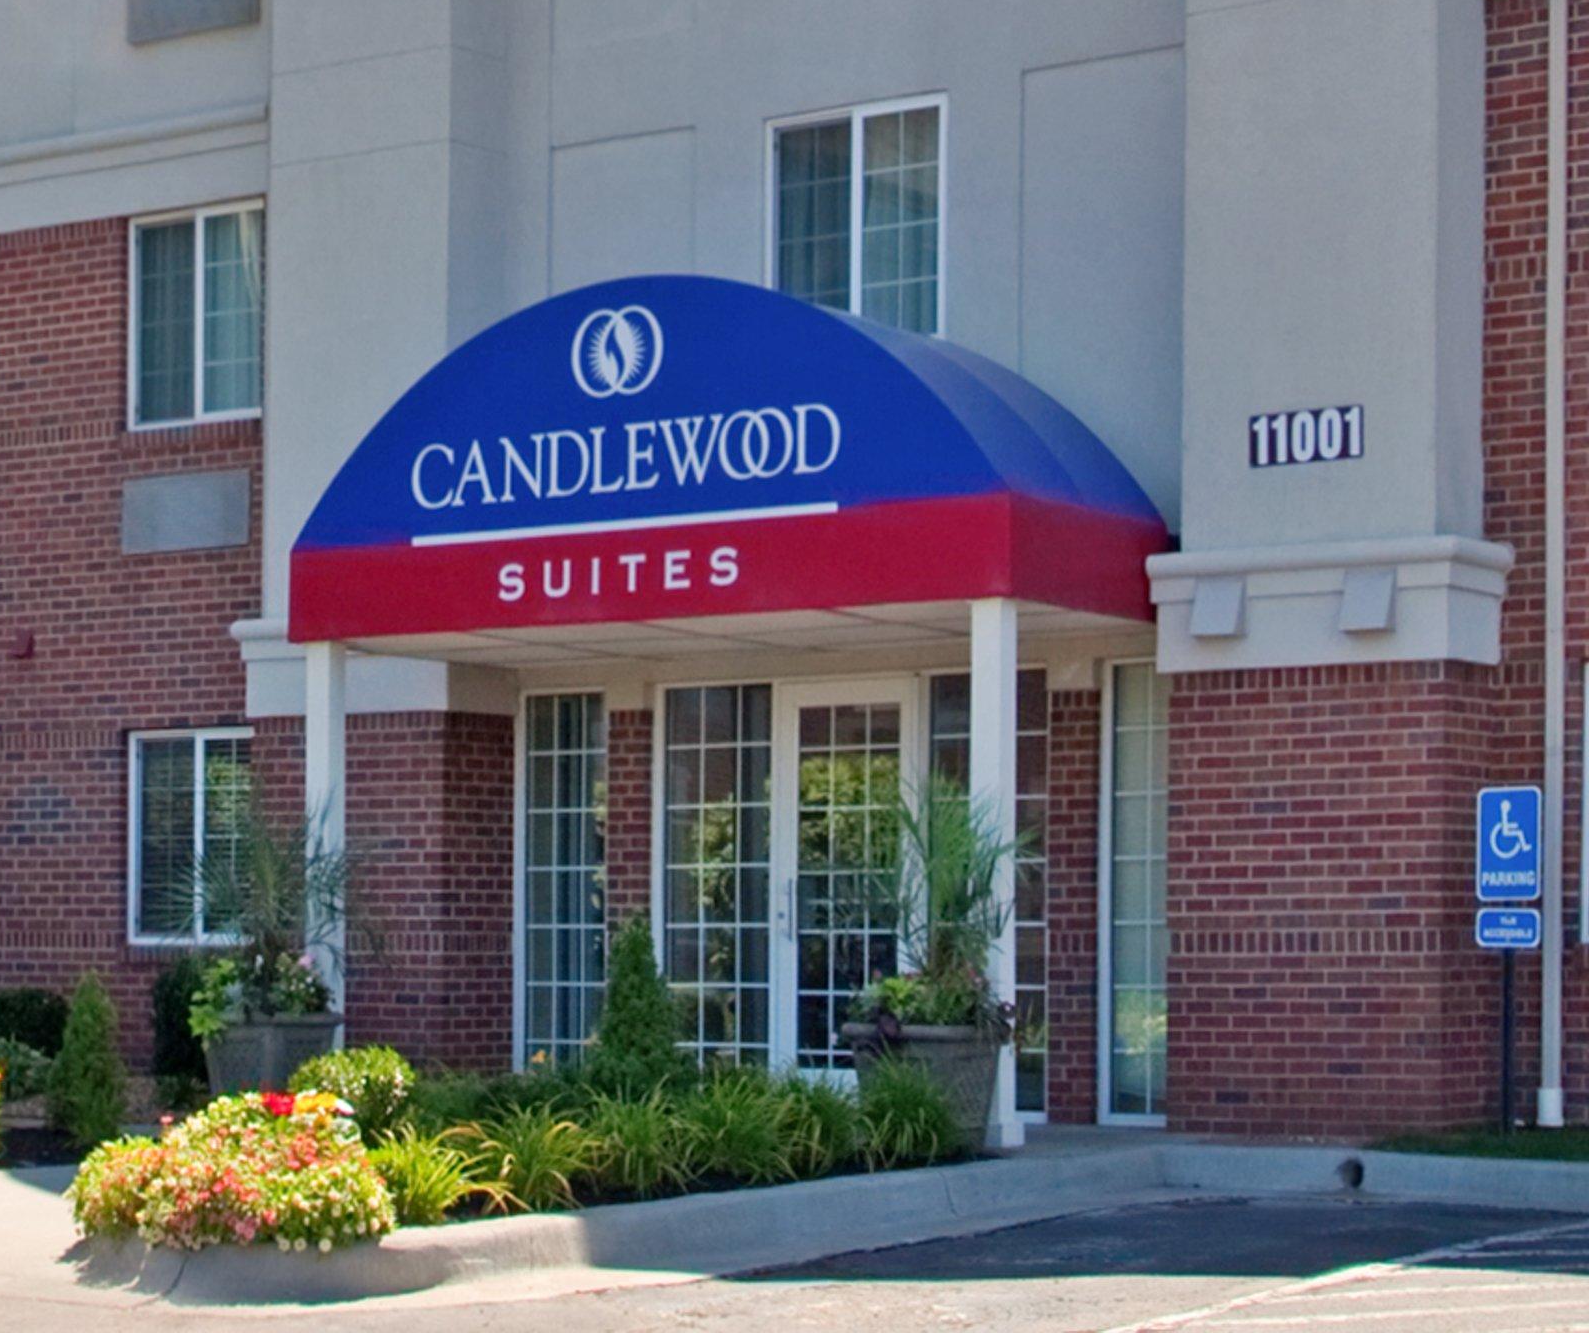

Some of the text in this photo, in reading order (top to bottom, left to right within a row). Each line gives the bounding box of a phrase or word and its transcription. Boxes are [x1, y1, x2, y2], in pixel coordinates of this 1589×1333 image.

[411, 403, 842, 510] CANDLEWOOD
[1252, 405, 1361, 465] 11001
[497, 546, 740, 602] SUITES
[1482, 871, 1535, 886] PARKING
